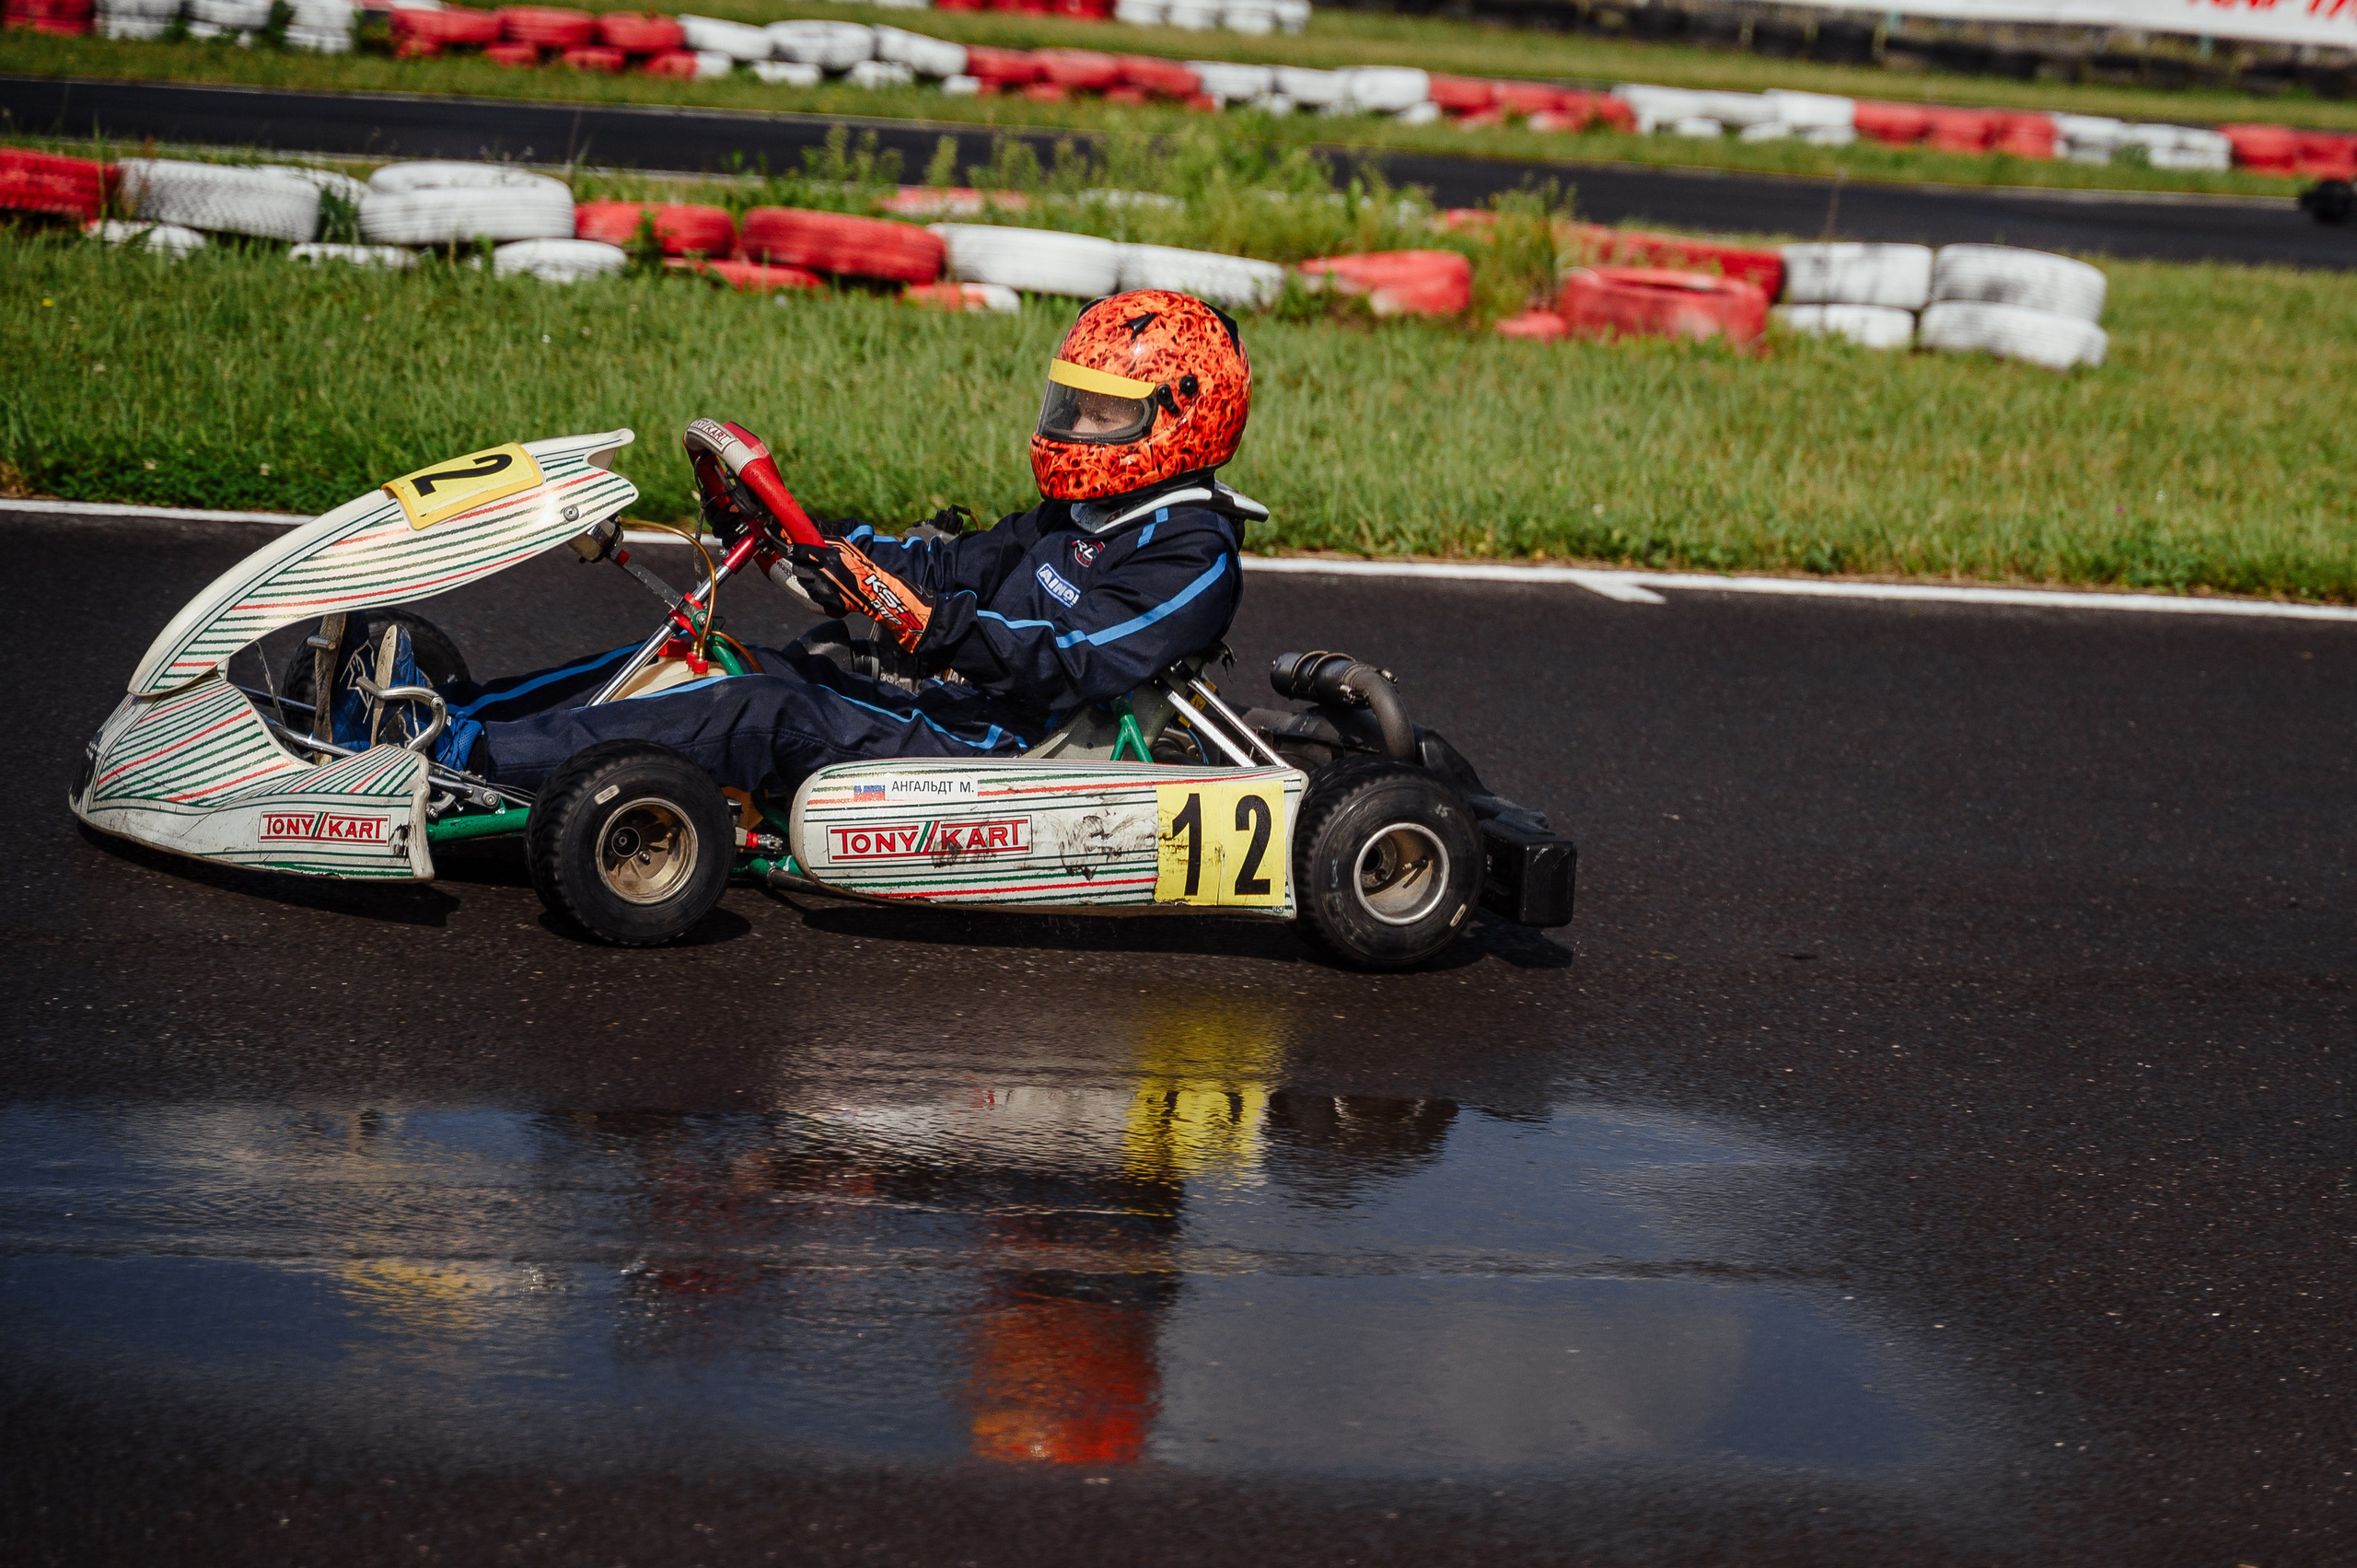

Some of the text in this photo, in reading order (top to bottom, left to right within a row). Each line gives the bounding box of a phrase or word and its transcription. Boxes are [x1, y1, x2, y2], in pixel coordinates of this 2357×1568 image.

[704, 424, 732, 442] KART
[411, 454, 513, 497] 2
[891, 780, 975, 796] АНГАЛЬДТ М.
[329, 815, 388, 839] KART
[941, 819, 1028, 850] KART
[1171, 792, 1271, 896] 12
